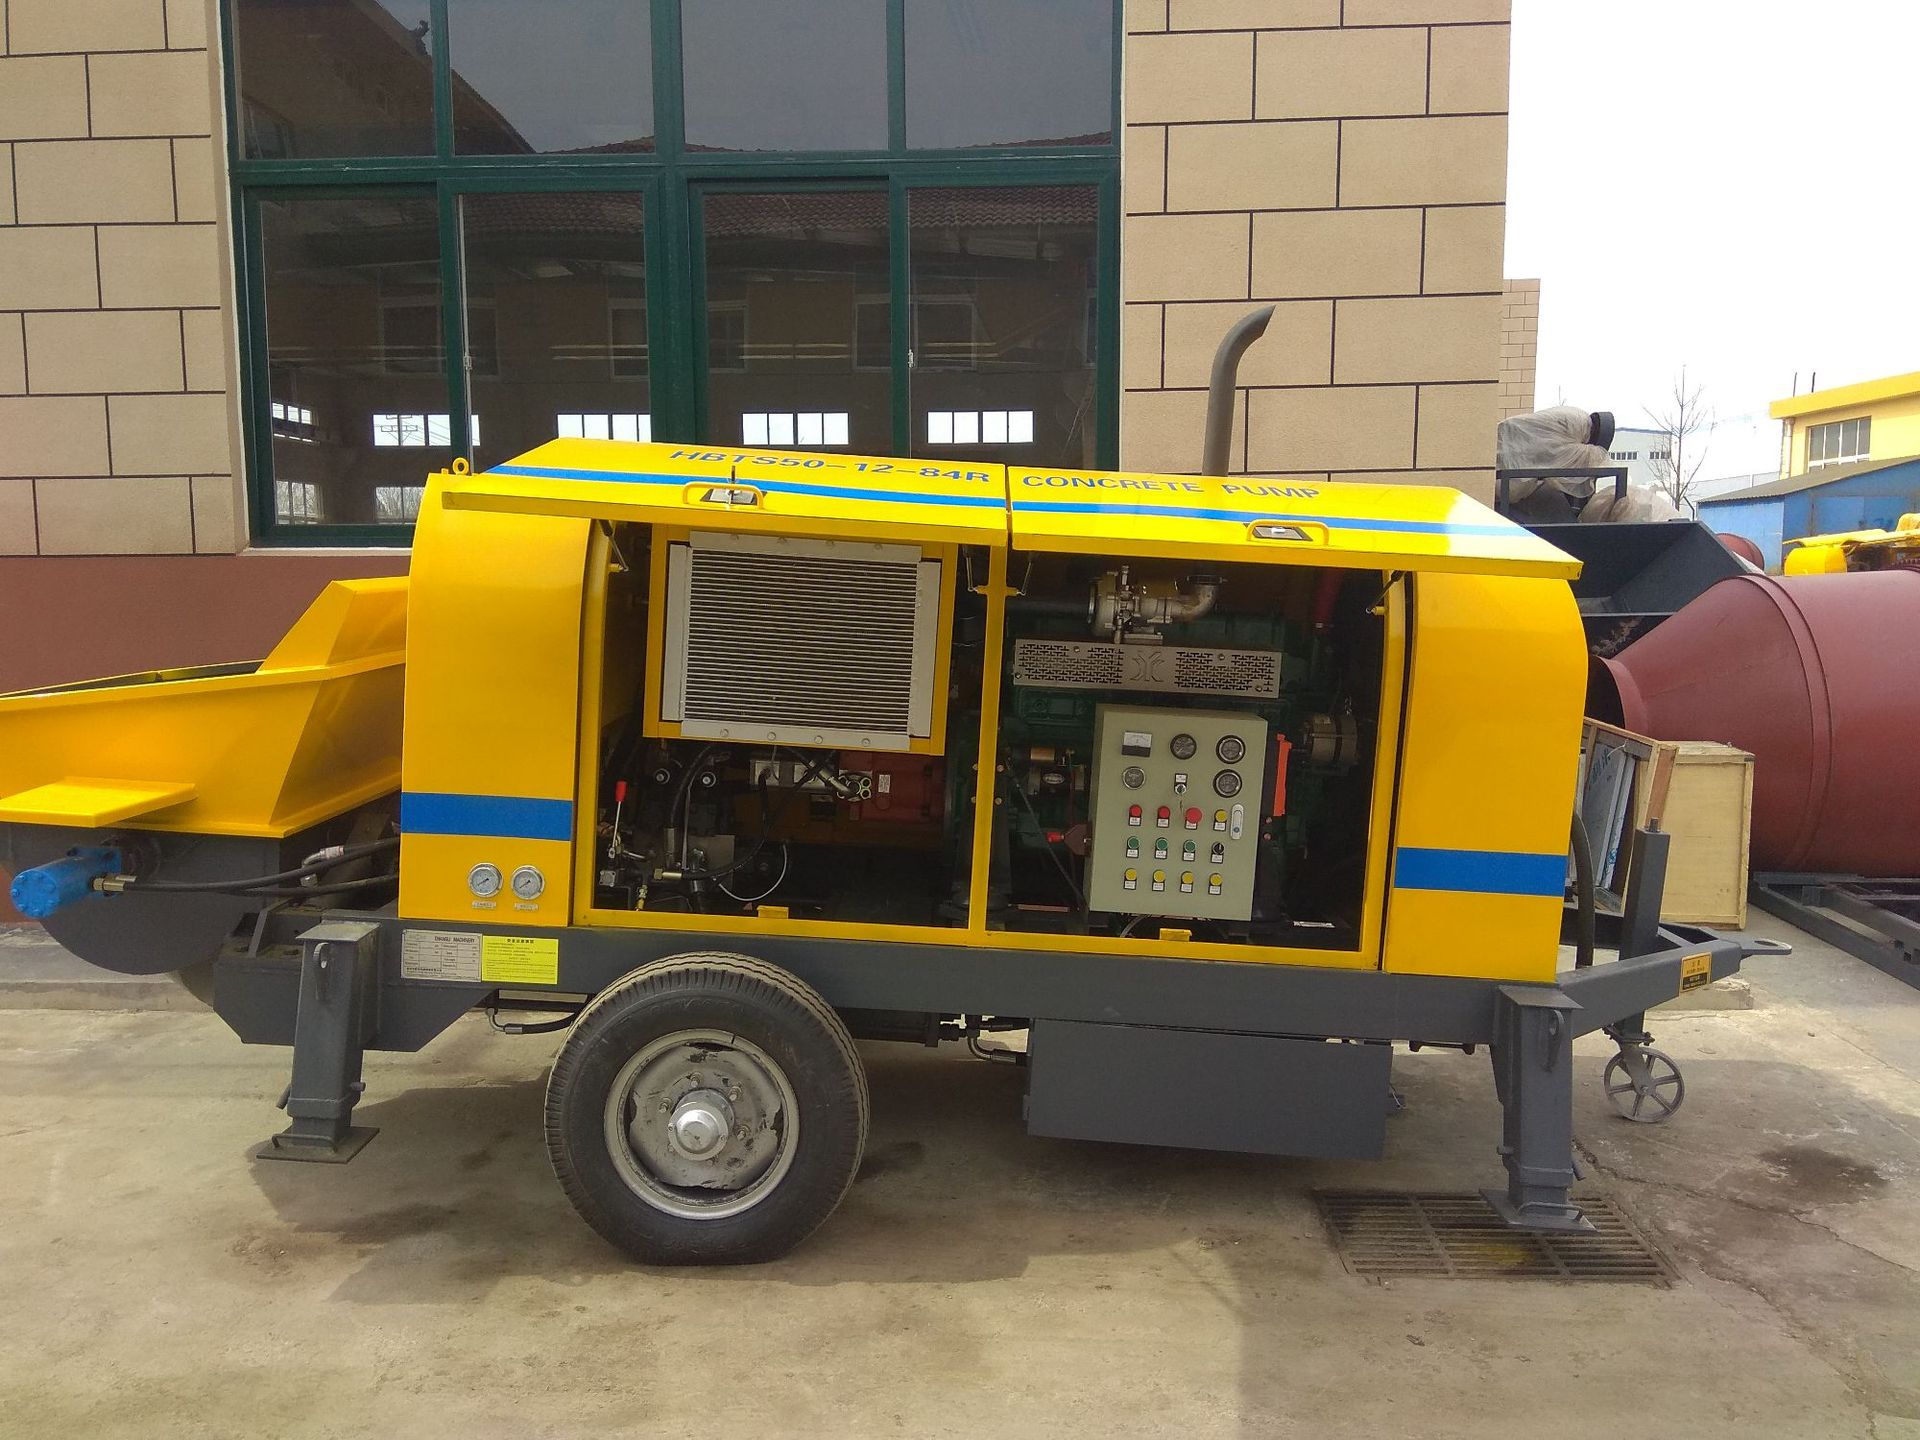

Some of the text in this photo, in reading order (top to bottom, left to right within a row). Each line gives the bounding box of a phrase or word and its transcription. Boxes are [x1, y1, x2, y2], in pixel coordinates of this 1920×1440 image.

[669, 450, 991, 482] HBTS50-12-84R
[1022, 475, 1320, 498] CONCRETE PUMP
